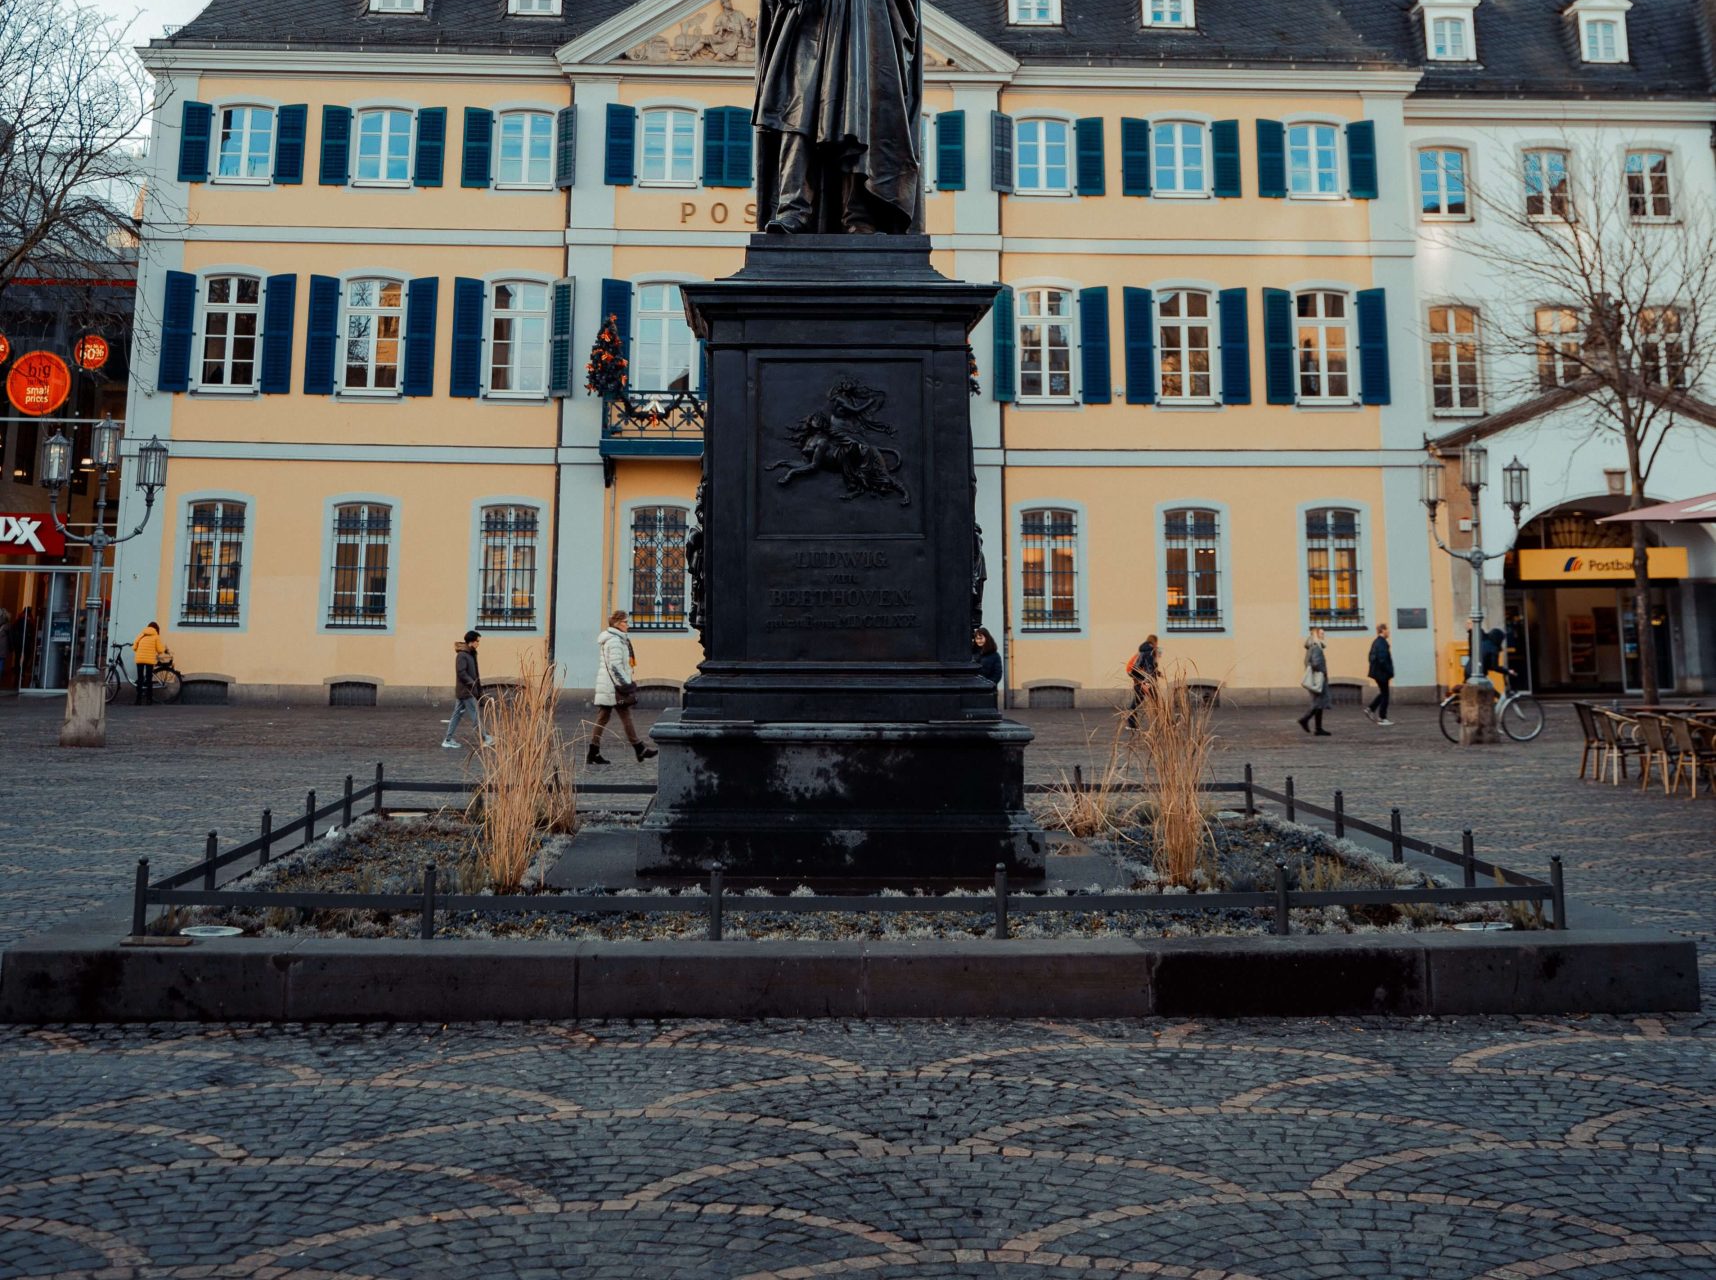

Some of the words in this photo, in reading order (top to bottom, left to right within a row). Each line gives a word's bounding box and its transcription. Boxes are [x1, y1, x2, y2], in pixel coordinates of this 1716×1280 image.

[680, 202, 757, 224] POS
[26, 385, 49, 395] small
[25, 395, 49, 405] prices
[794, 550, 888, 569] LUDWIG
[1589, 559, 1633, 571] Postba
